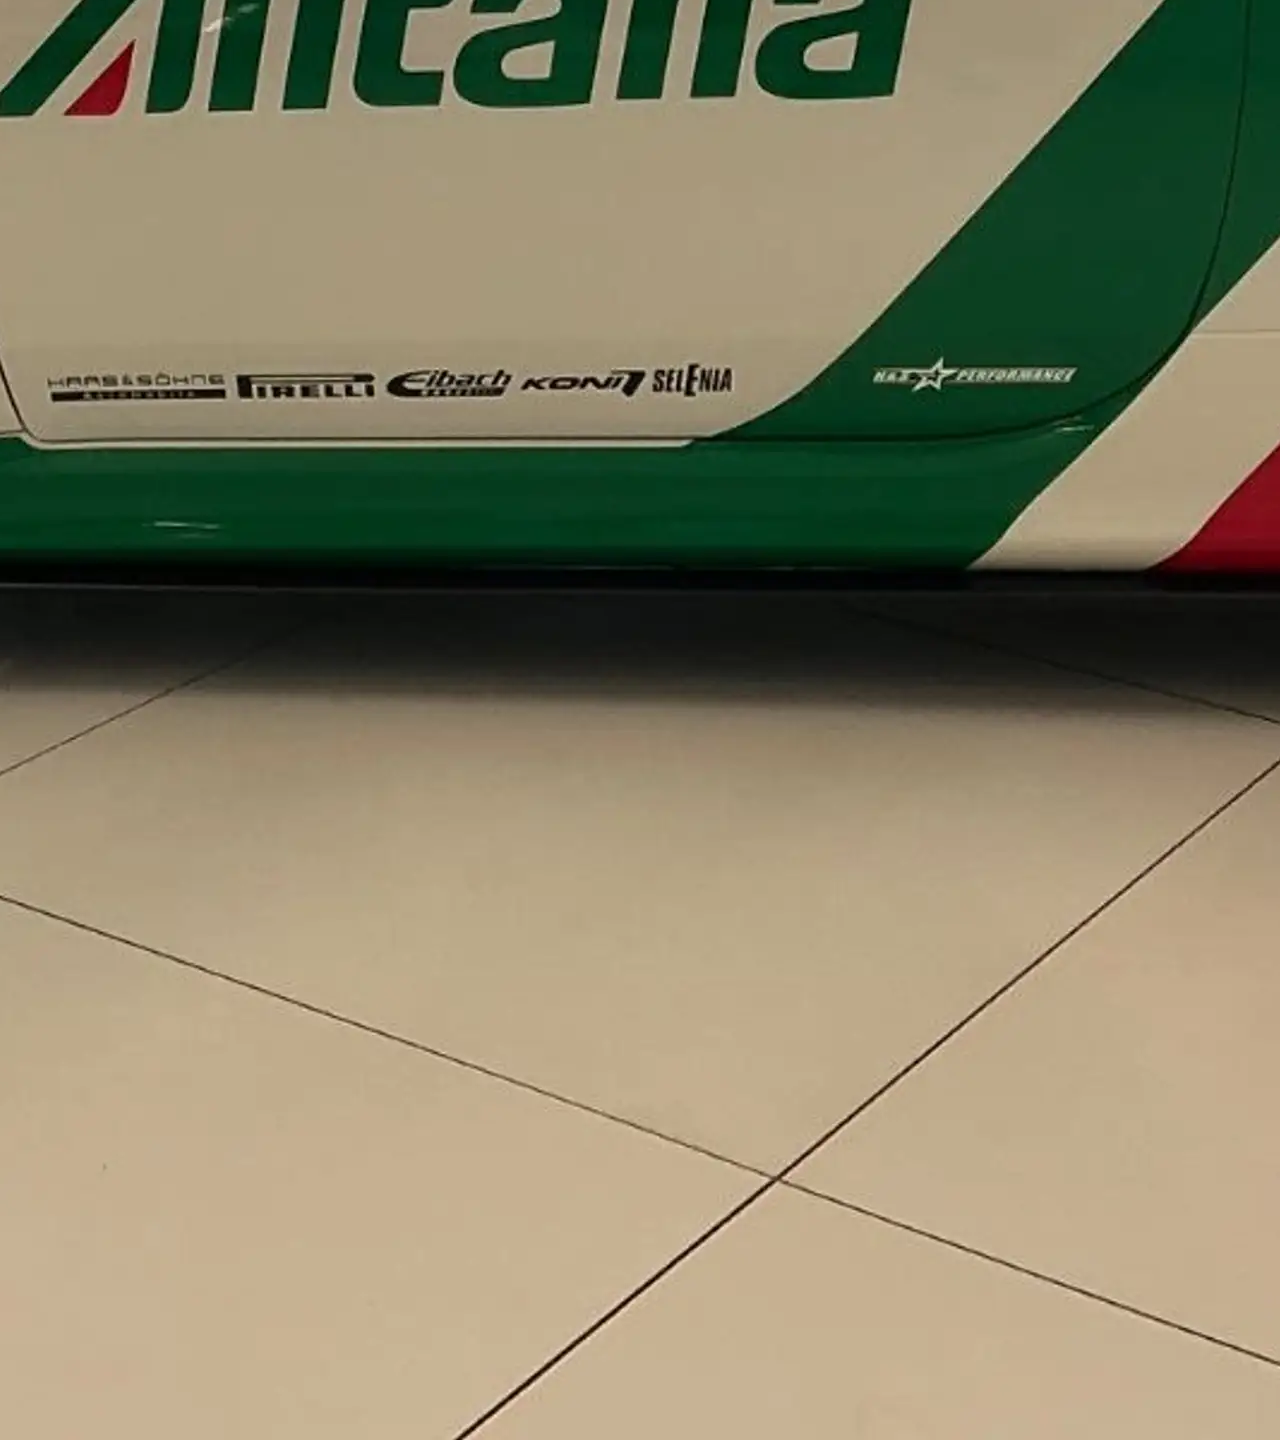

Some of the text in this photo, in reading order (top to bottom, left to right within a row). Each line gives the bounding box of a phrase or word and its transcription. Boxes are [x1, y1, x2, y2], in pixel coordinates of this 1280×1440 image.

[237, 374, 375, 398] PIRELLI
[386, 370, 512, 396] Eibach
[521, 370, 645, 397] KONI
[652, 364, 733, 397] SELENIA
[955, 367, 1077, 383] PERFORMANCE
